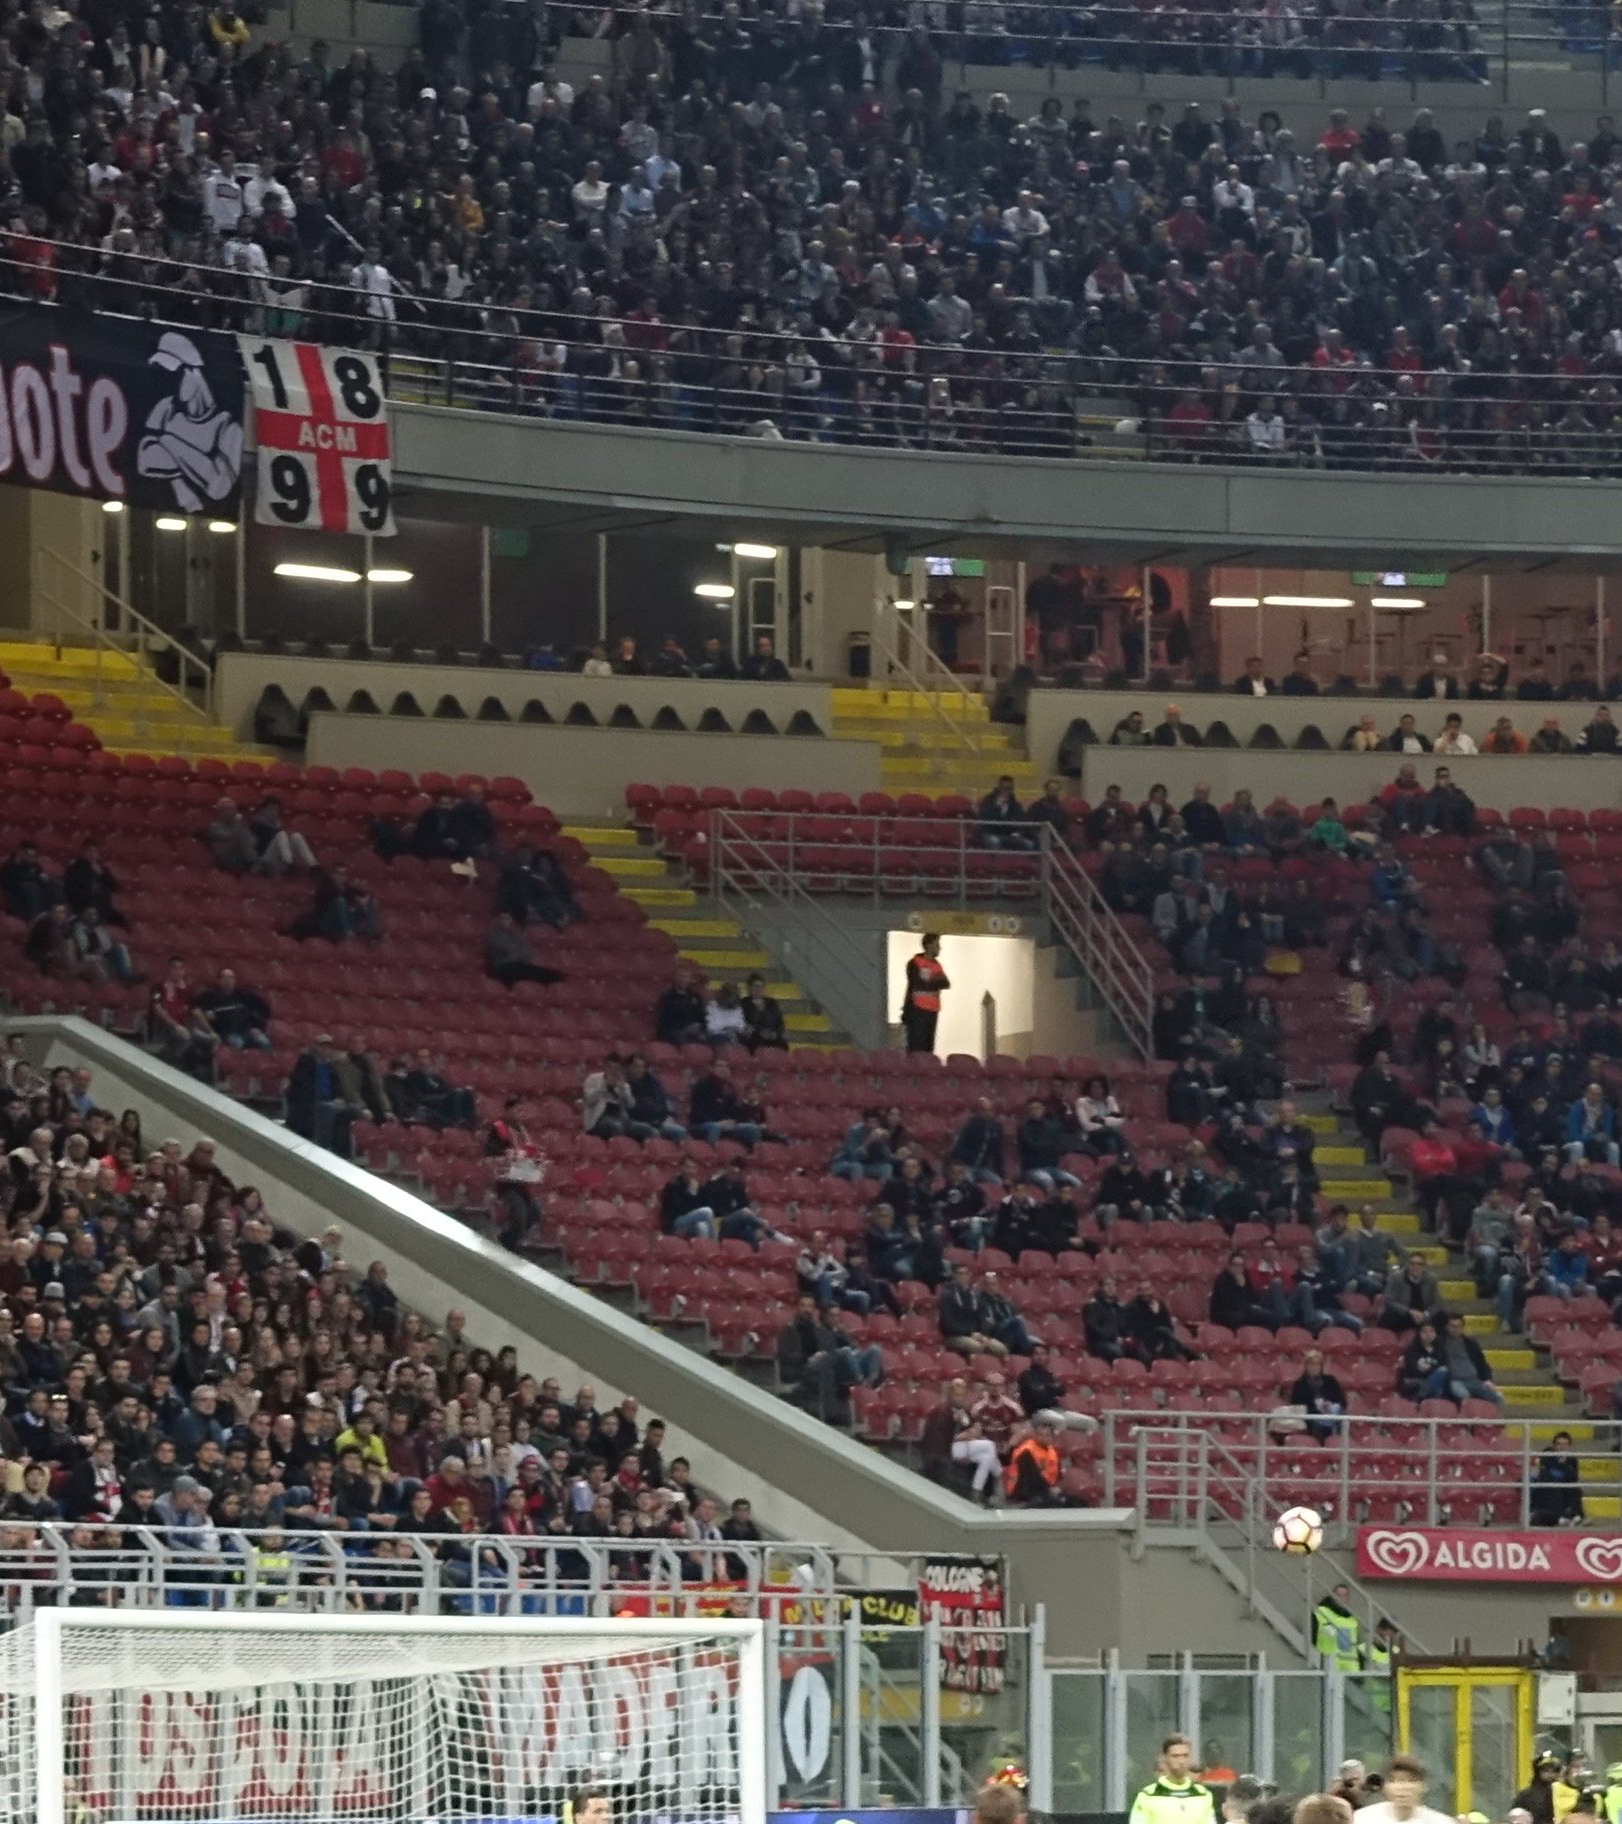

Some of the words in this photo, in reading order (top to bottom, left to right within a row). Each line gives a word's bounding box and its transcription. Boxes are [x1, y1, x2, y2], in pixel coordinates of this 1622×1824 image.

[253, 344, 289, 409] 1
[334, 356, 381, 419] 8
[298, 420, 358, 451] ACM
[270, 454, 312, 523] 9
[355, 464, 389, 531] 9
[1434, 1538, 1547, 1573] ALGIDA
[862, 1596, 919, 1627] CLUB
